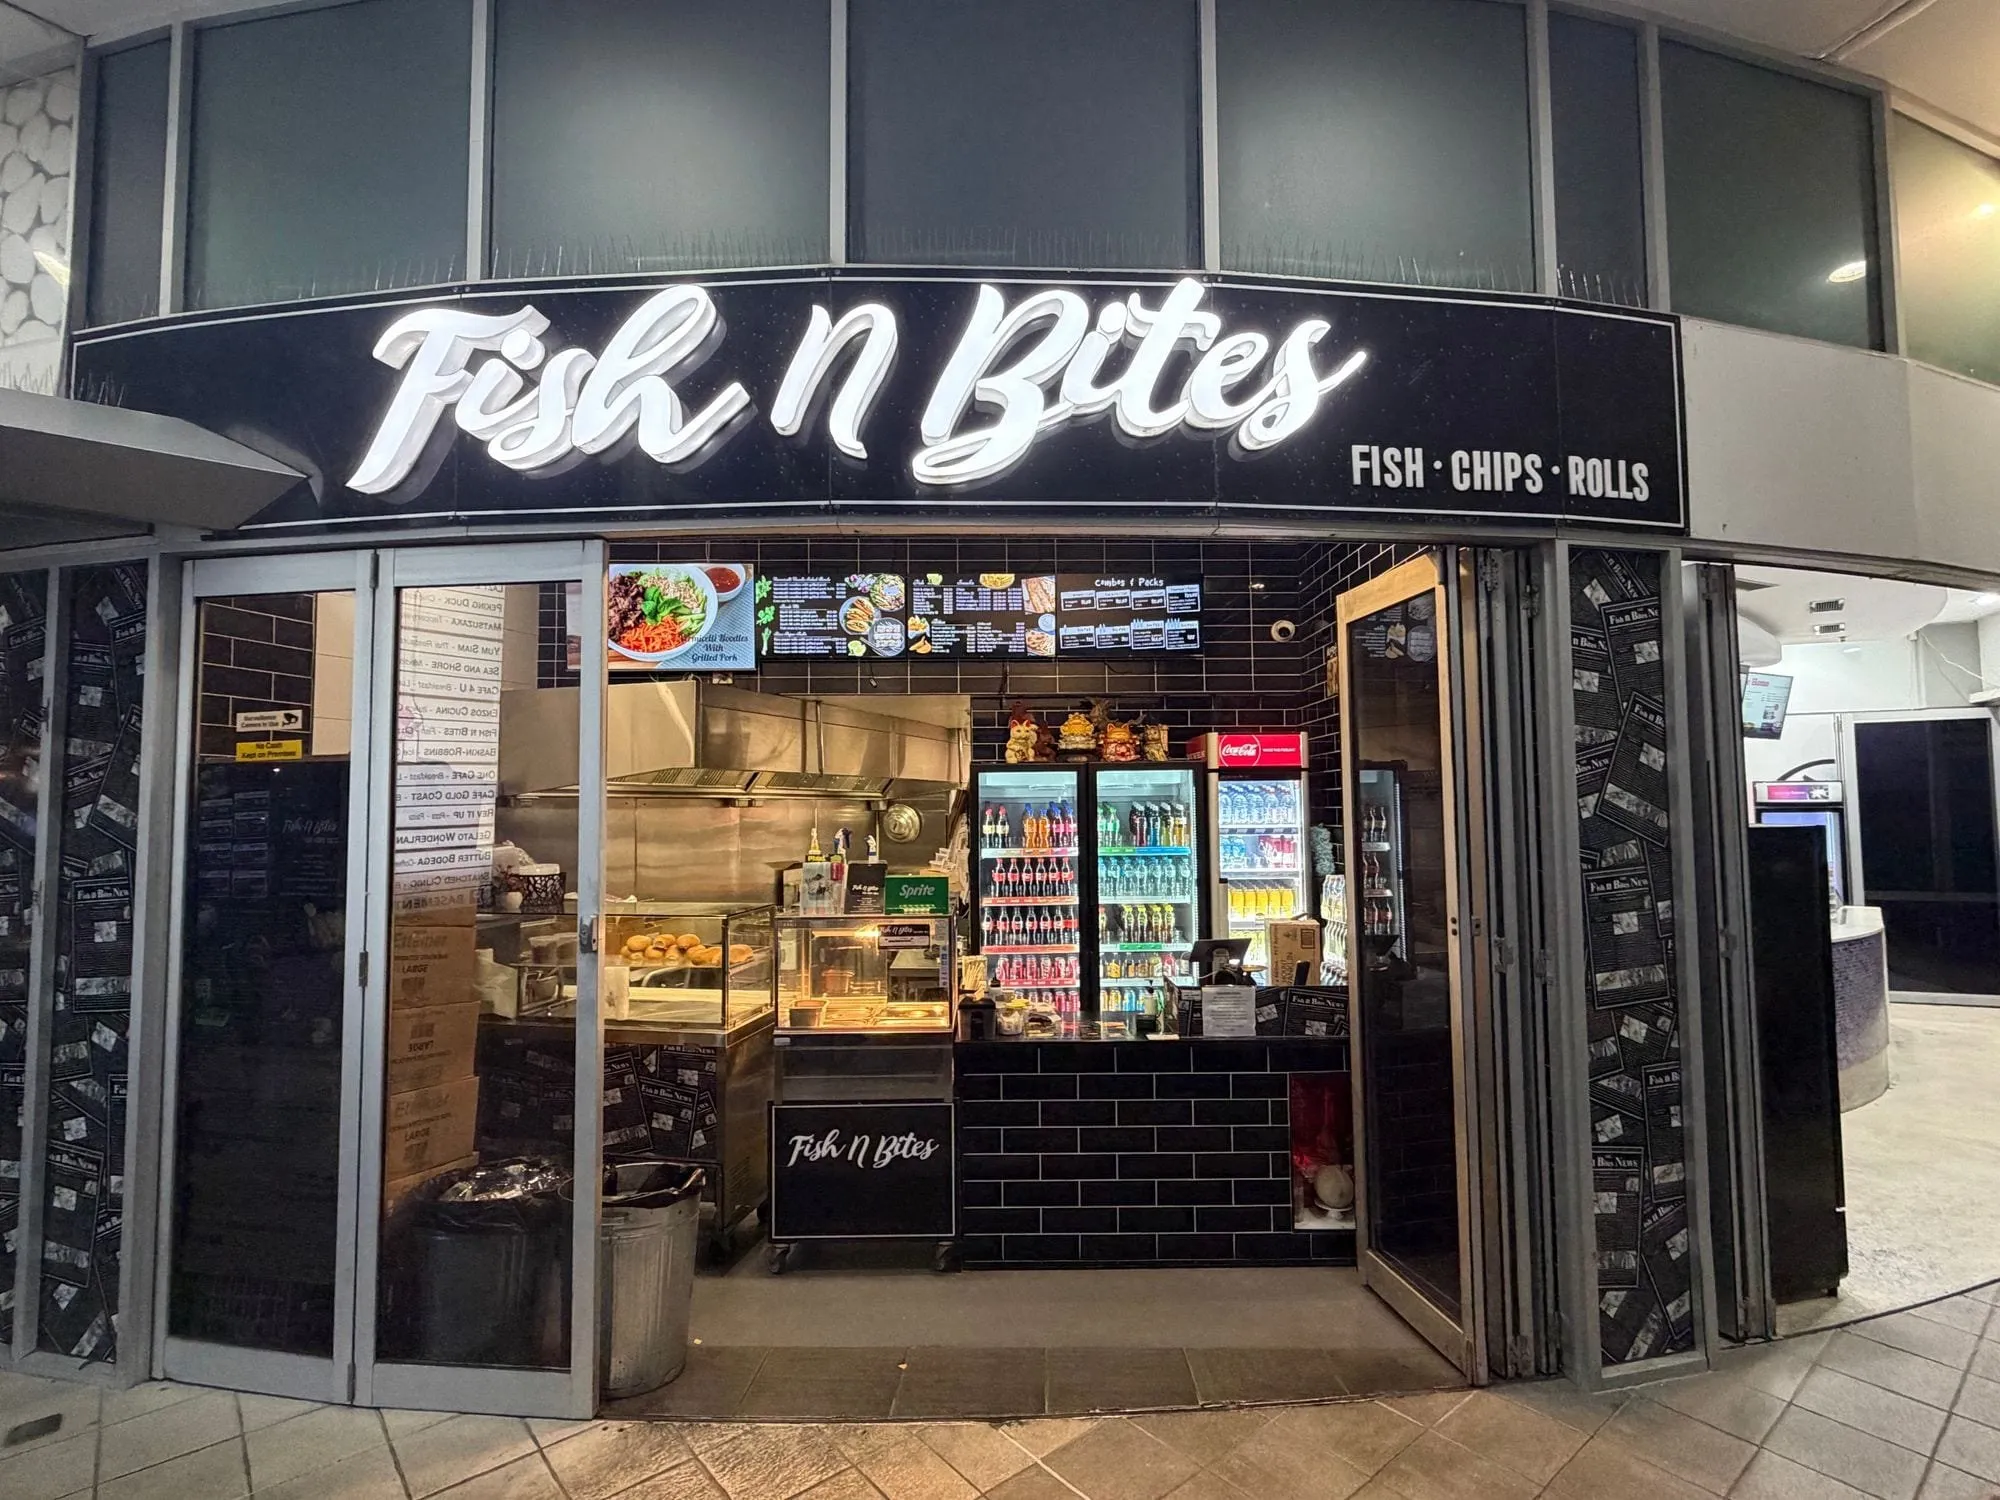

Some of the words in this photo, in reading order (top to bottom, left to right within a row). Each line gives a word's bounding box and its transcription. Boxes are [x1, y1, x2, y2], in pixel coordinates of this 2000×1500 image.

[345, 284, 751, 496] Fish
[912, 277, 1368, 486] Bites
[1351, 445, 1425, 488] FISH
[1451, 450, 1544, 494] CHIPS
[1567, 455, 1650, 502] ROLLS
[719, 633, 749, 643] Noodles
[691, 653, 718, 664] Grilled
[720, 652, 738, 662] Pork
[1222, 743, 1258, 757] Coca-Cola
[899, 884, 936, 899] Sprite
[402, 963, 429, 974] LARGE
[786, 1129, 847, 1168] Fish
[872, 1132, 940, 1169] Bites
